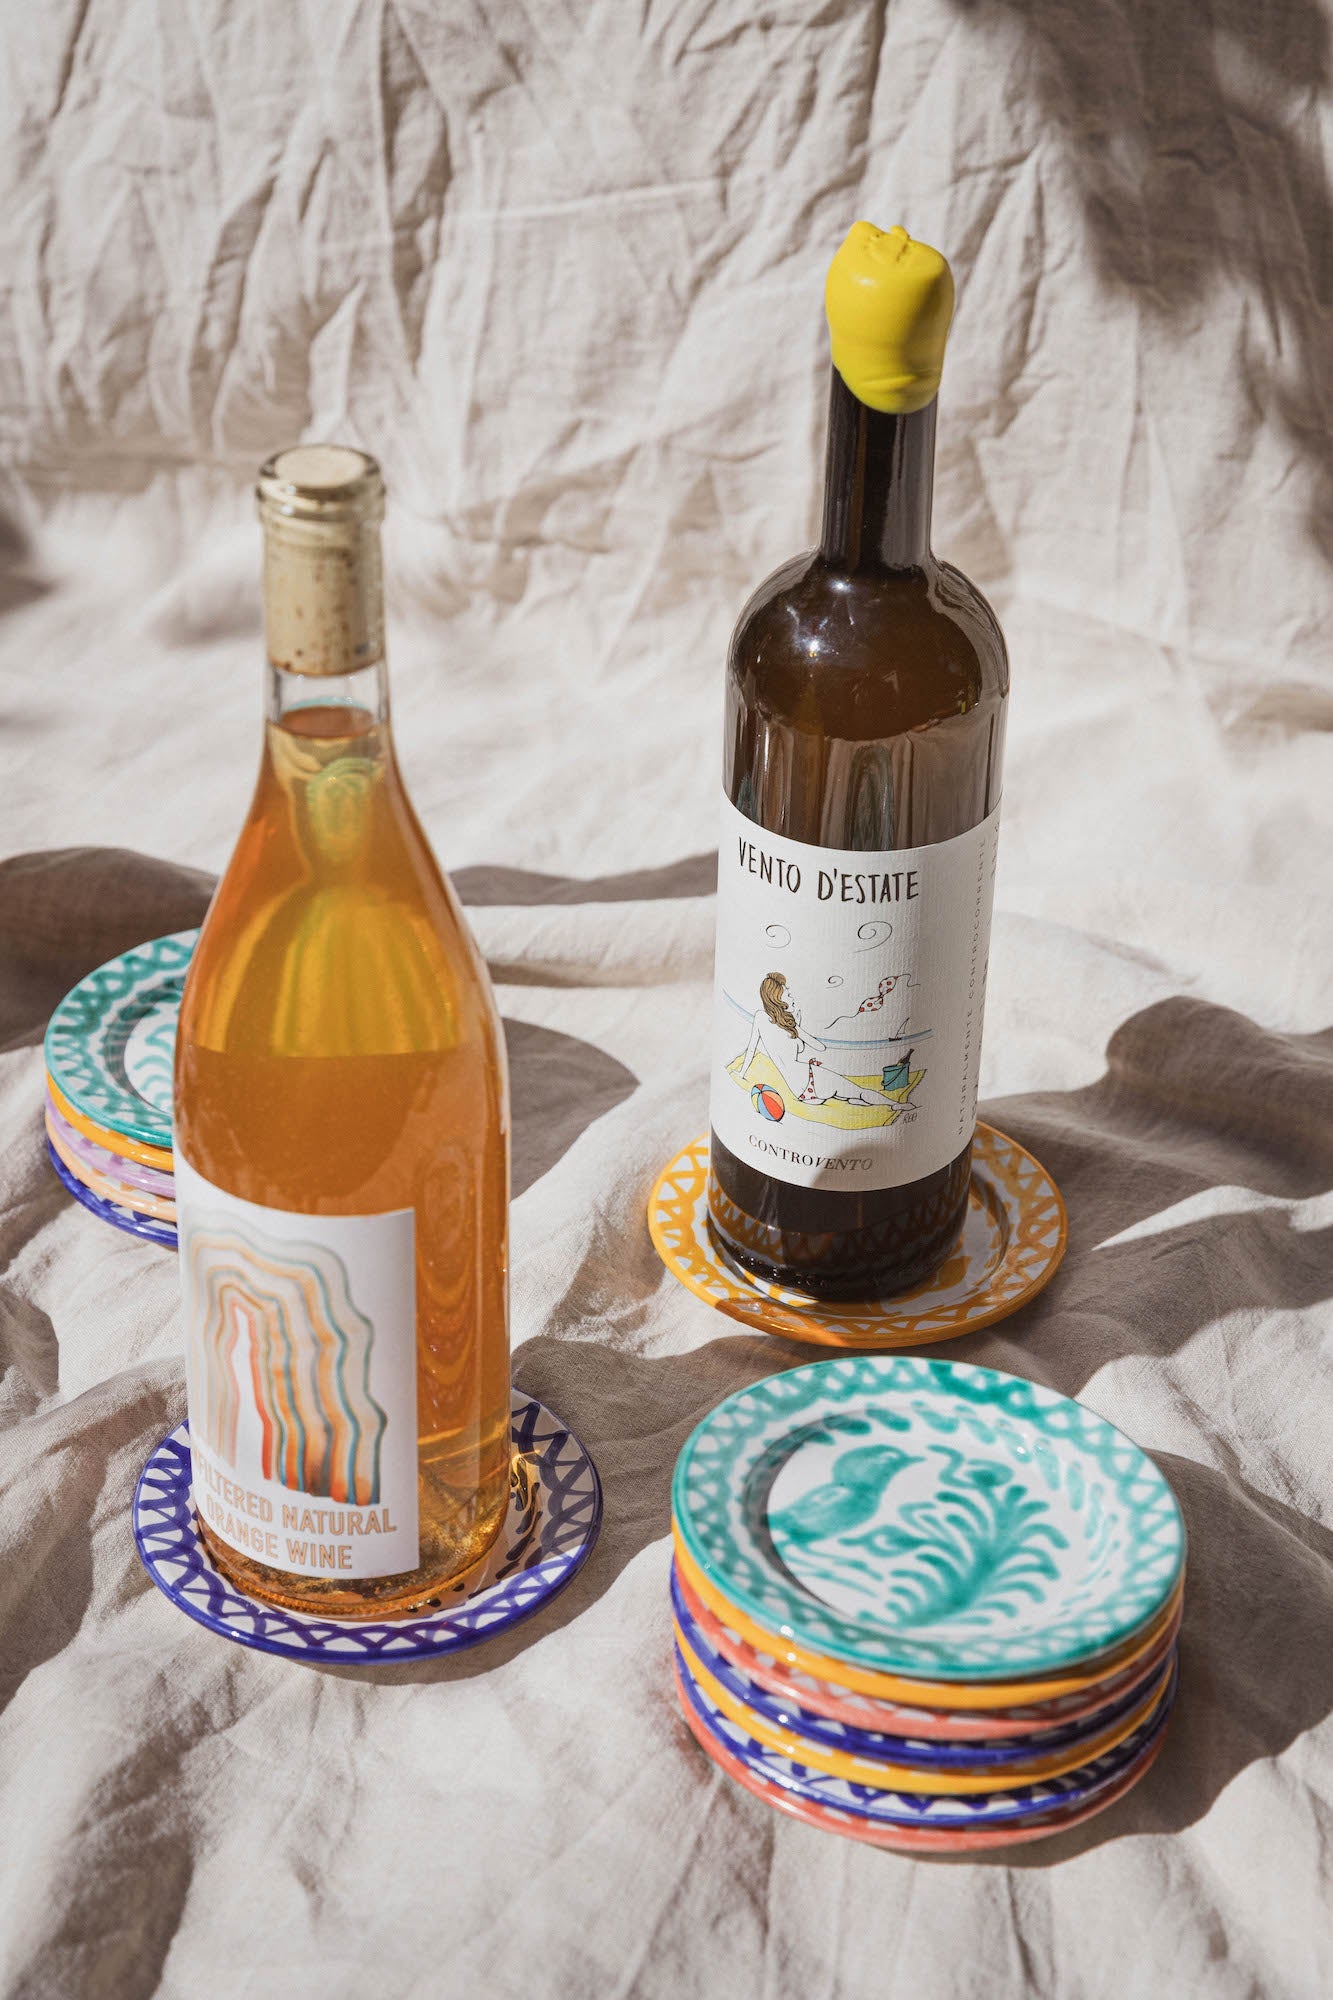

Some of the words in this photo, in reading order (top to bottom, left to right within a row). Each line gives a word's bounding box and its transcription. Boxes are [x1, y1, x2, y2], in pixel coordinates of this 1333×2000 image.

[739, 836, 801, 893] VENTO
[817, 868, 919, 904] D'ESTATE
[958, 1008, 973, 1135] NATURALMENTE
[966, 839, 985, 999] CONTROCORRENTE
[748, 1134, 873, 1171] CONTROVENTO
[206, 1493, 279, 1559] ORANGE
[286, 1539, 353, 1570] WINE
[282, 1504, 398, 1536] NATURAL
